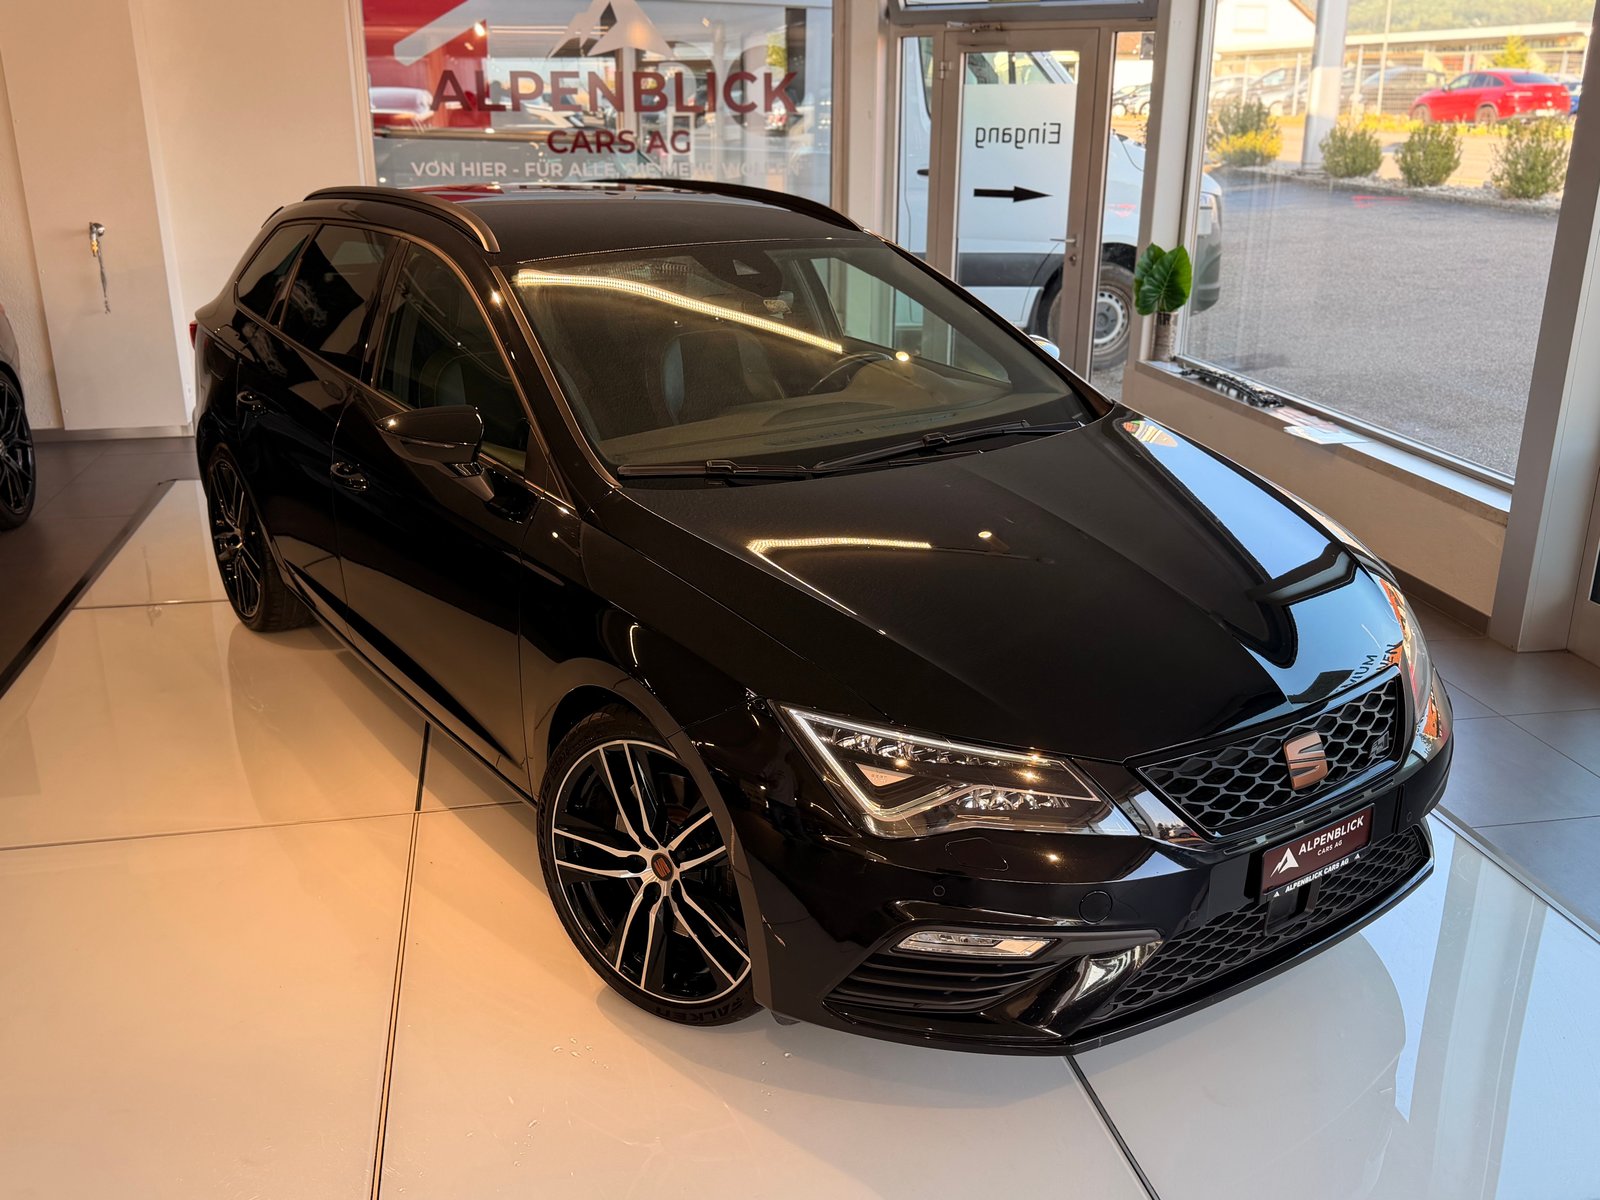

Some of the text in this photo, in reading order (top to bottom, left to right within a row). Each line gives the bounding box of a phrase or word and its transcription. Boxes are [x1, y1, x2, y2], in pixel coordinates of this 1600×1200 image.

[430, 70, 799, 114] ALPENBLICK
[547, 130, 691, 155] CARS AG
[411, 161, 456, 178] VON
[462, 162, 507, 178] HIER
[525, 158, 563, 178] FÜR
[1298, 815, 1365, 856] ALPENBLICK
[1317, 840, 1343, 856] CARS AG
[1285, 857, 1350, 893] ALPENBLICK CARS AG
